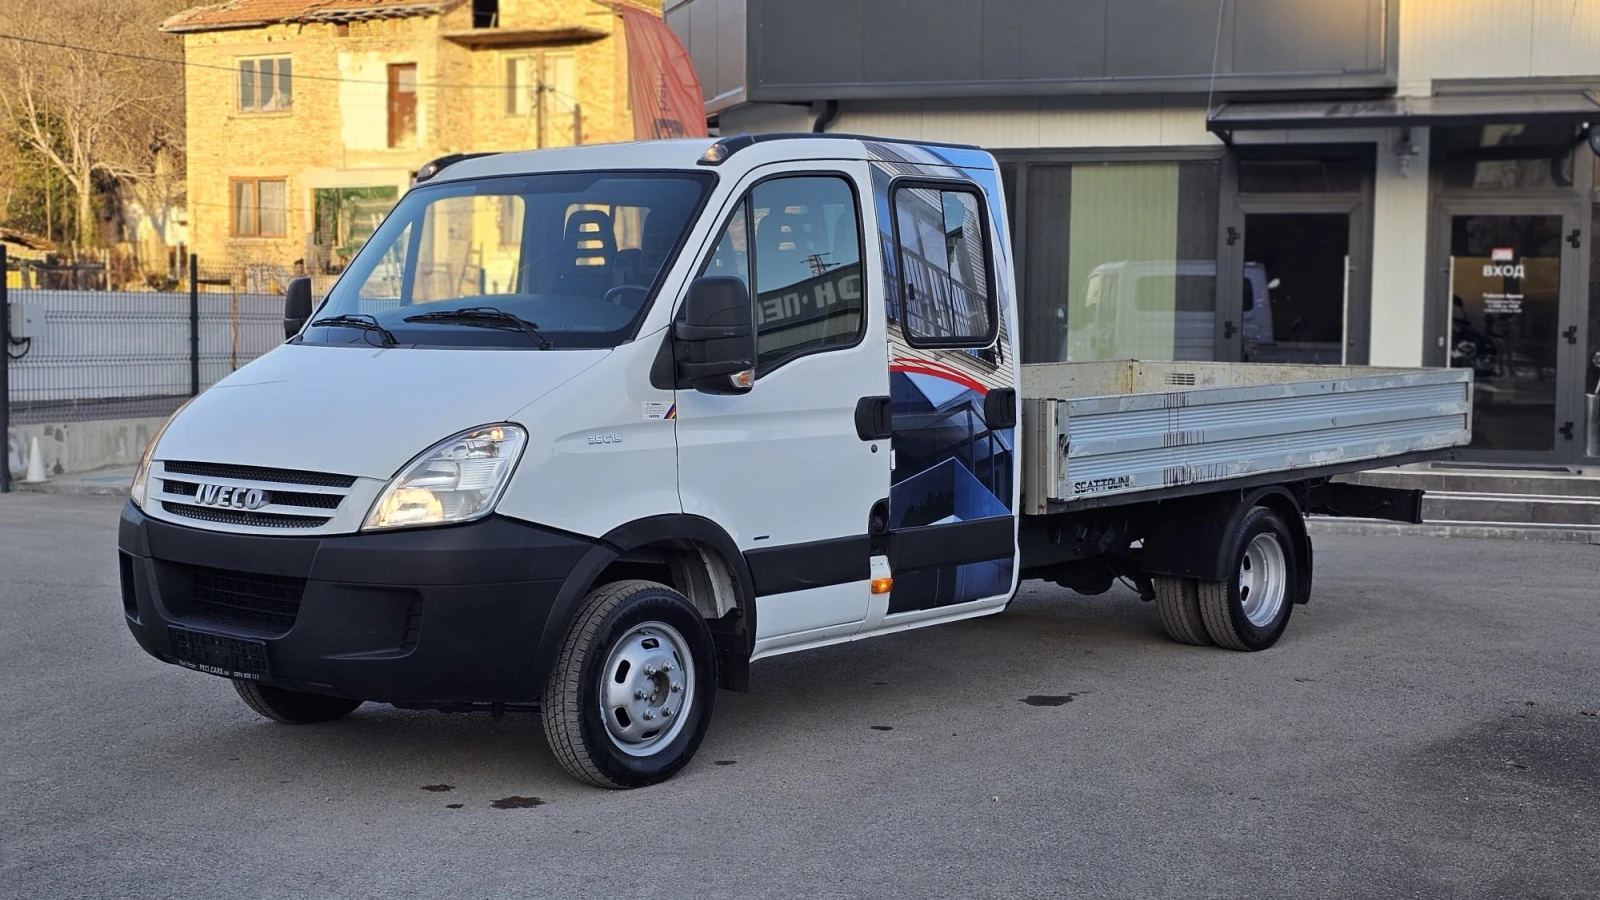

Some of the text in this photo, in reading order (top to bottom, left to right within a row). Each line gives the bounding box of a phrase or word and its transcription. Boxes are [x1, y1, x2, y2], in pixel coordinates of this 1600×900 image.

[1482, 264, 1525, 279] ВХОД
[587, 433, 623, 446] 35C15
[195, 483, 264, 510] IVECO
